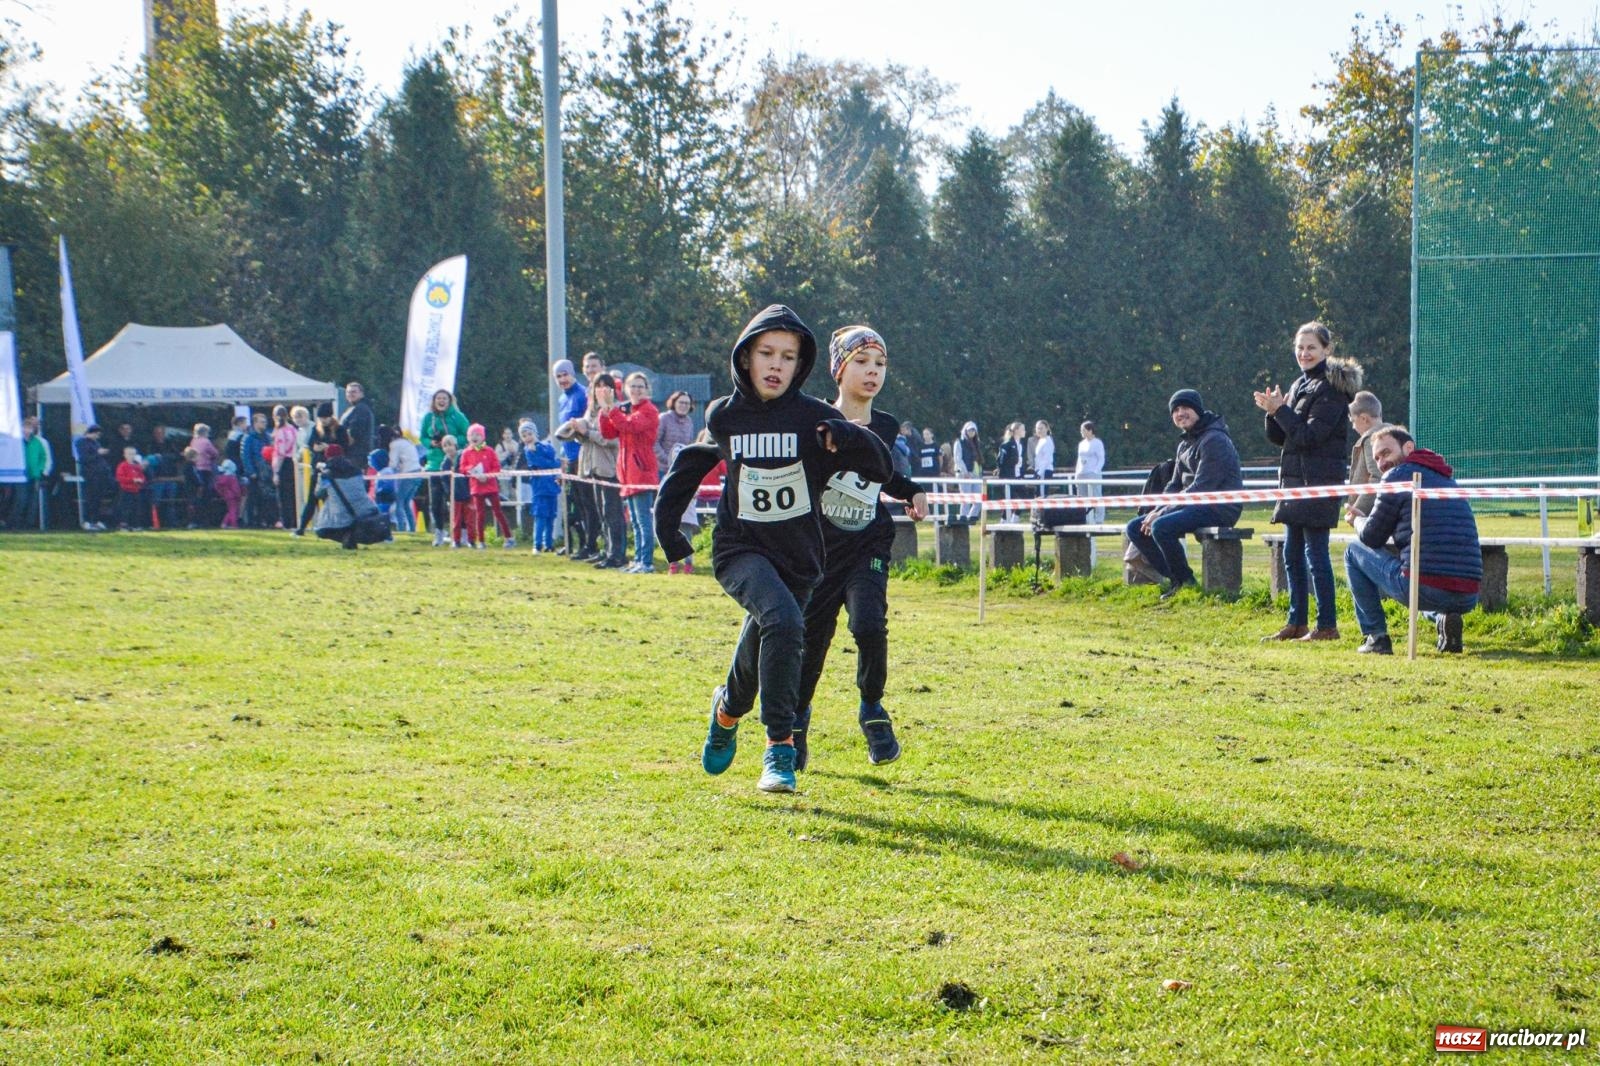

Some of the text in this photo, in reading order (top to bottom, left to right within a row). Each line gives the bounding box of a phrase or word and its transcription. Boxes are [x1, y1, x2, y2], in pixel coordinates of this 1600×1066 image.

[200, 387, 216, 399] DLA
[729, 432, 798, 460] PUMA
[751, 486, 796, 512] 80
[821, 502, 876, 521] WINTER
[842, 518, 859, 526] 2020
